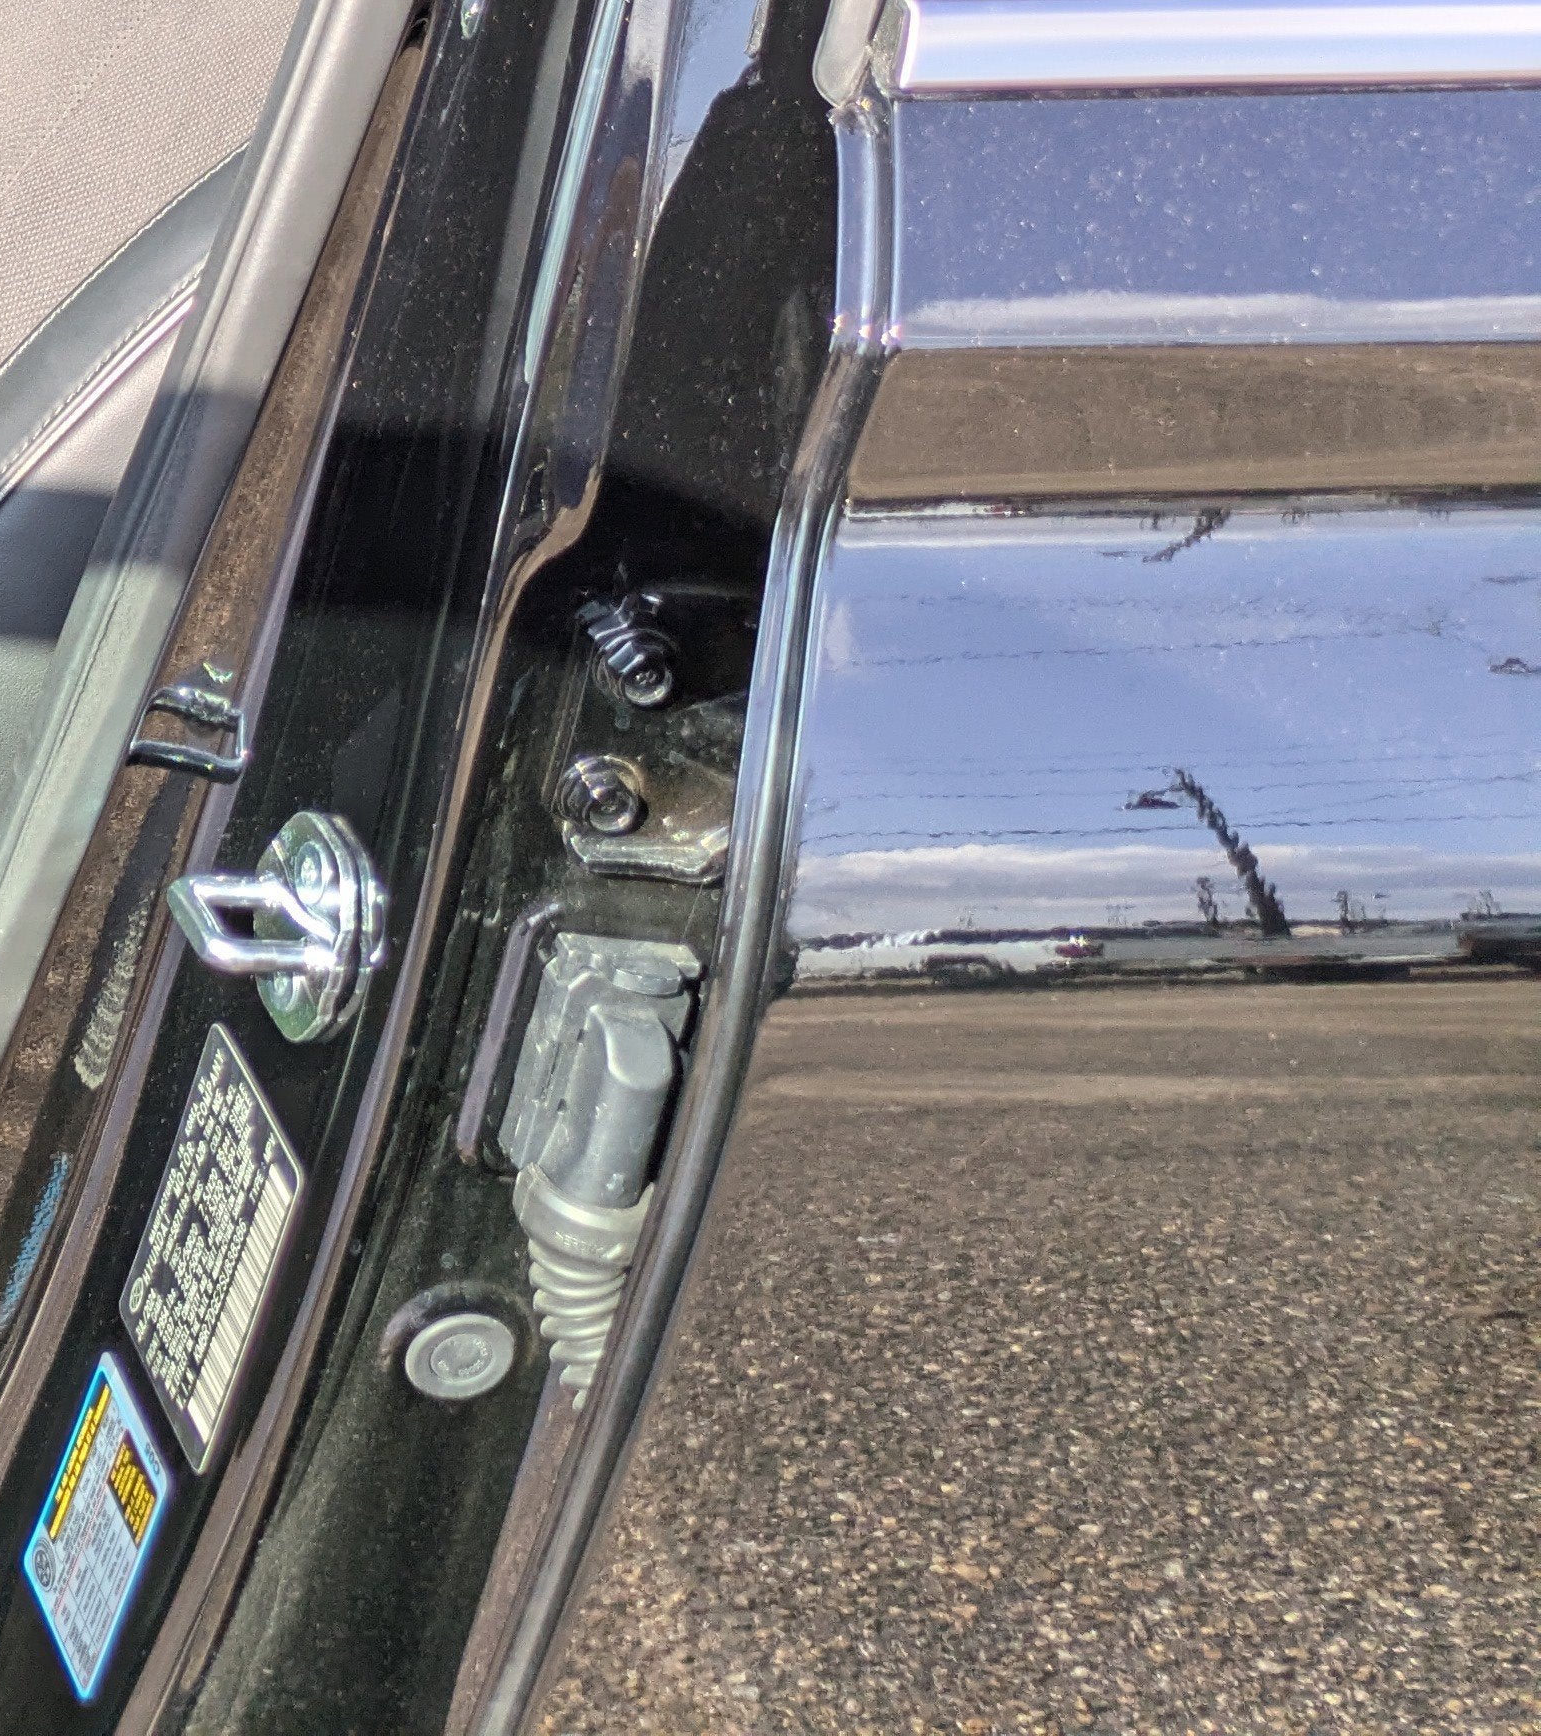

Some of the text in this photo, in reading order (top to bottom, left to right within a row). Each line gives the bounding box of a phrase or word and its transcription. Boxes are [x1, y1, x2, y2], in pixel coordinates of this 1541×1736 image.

[227, 1080, 247, 1129] SINGLE
[234, 1091, 252, 1139] SINGLE
[141, 1046, 225, 1287] HYUNDAI MOTOR COMPANY
[147, 1164, 177, 1246] MANUFACTURED
